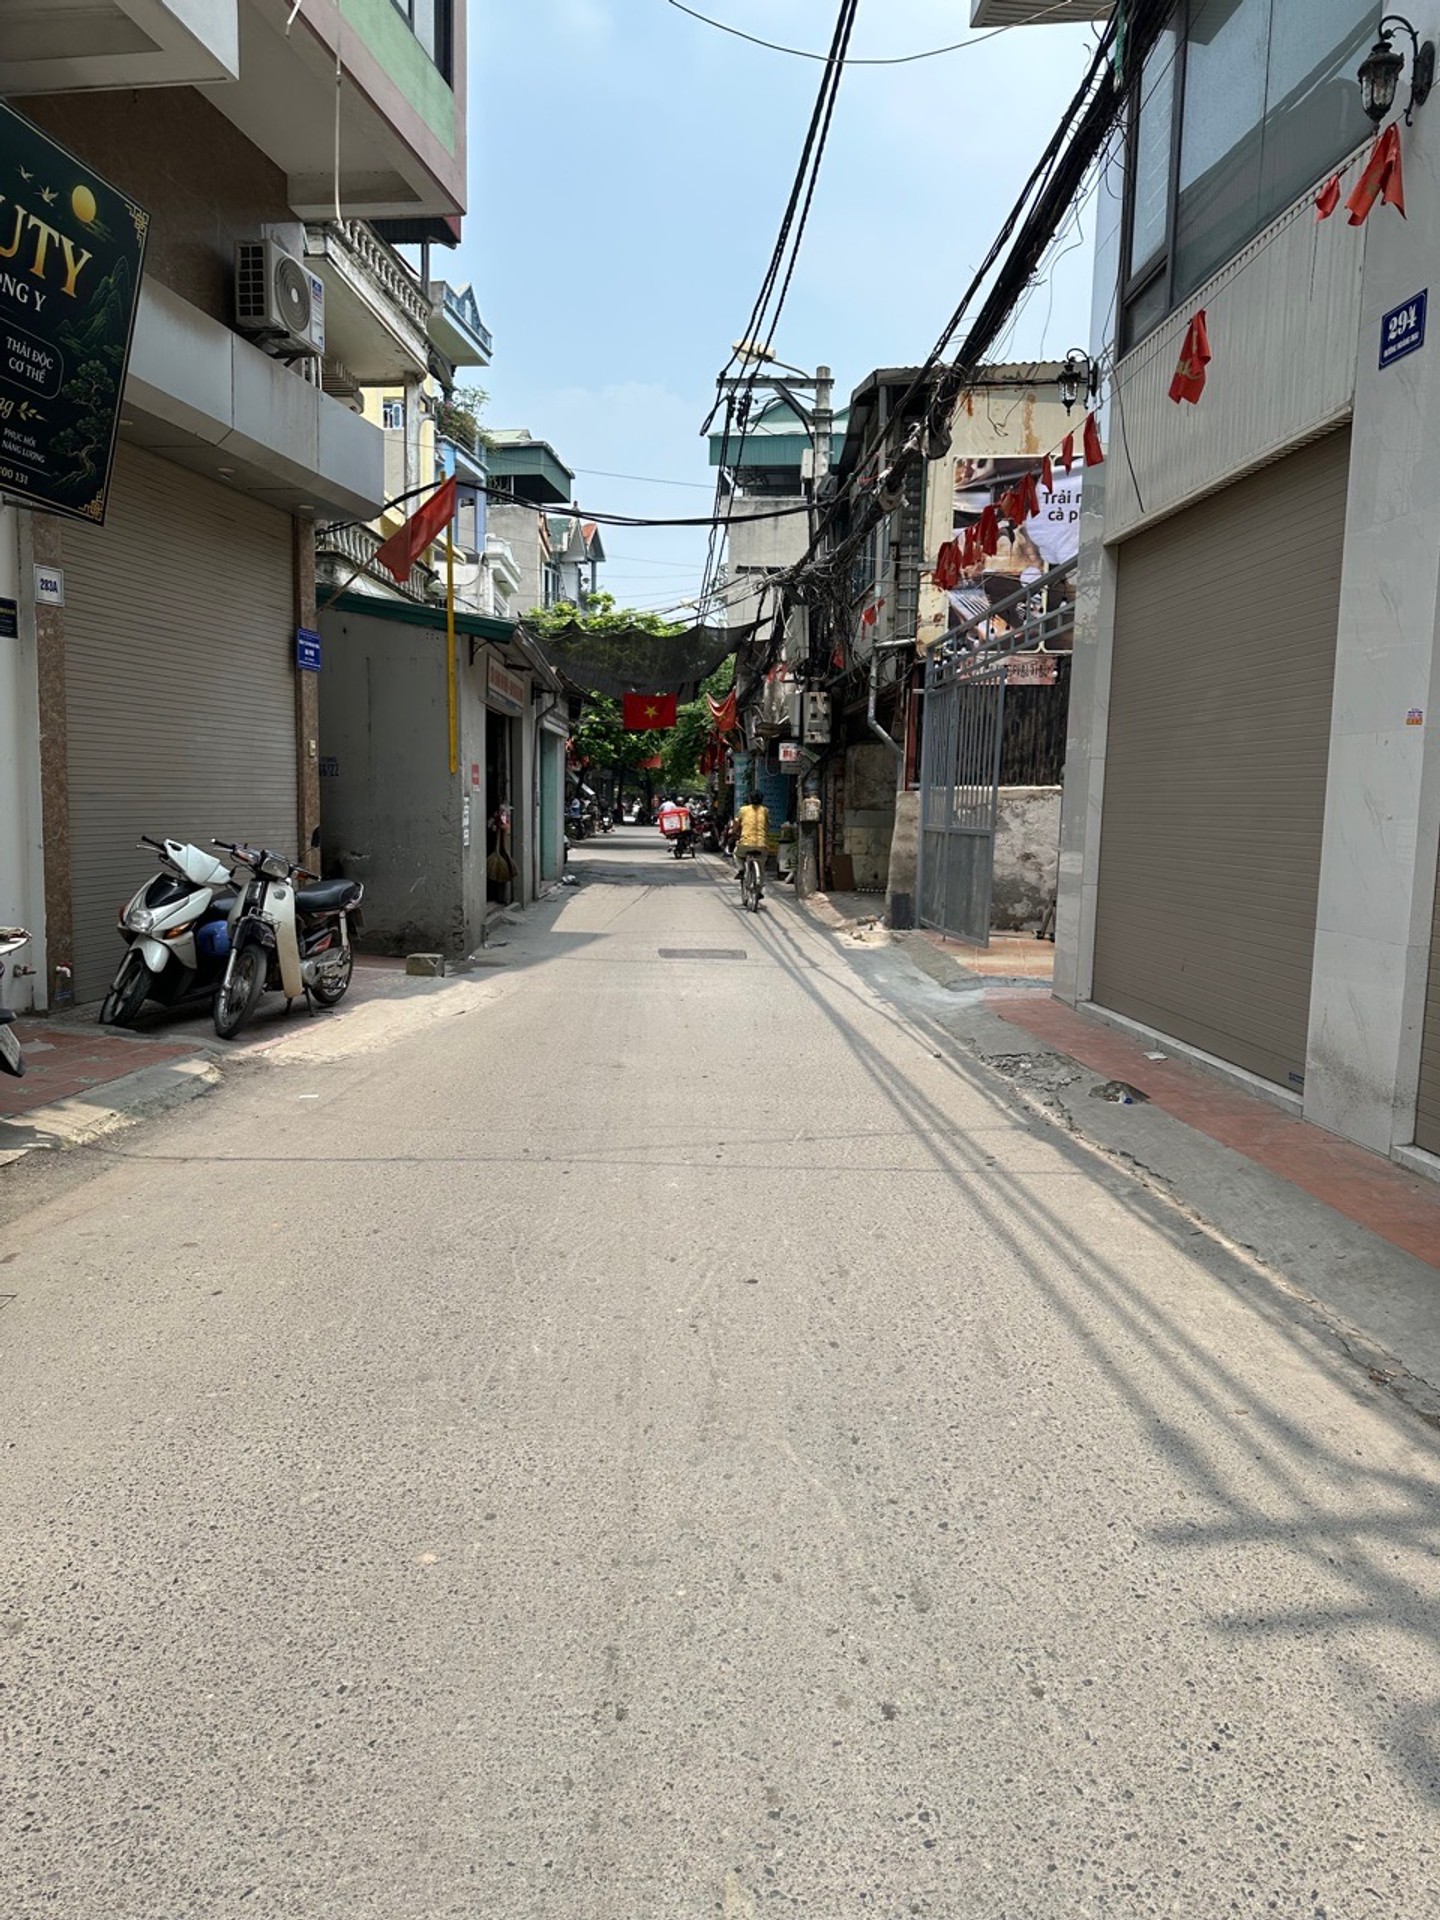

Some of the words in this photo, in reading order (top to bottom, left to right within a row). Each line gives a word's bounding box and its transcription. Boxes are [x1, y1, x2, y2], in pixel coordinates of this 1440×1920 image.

[0, 273, 29, 303] NG
[1388, 303, 1417, 341] 294
[8, 357, 25, 373] CƠ
[1042, 489, 1071, 505] Trải
[1048, 506, 1064, 521] cà
